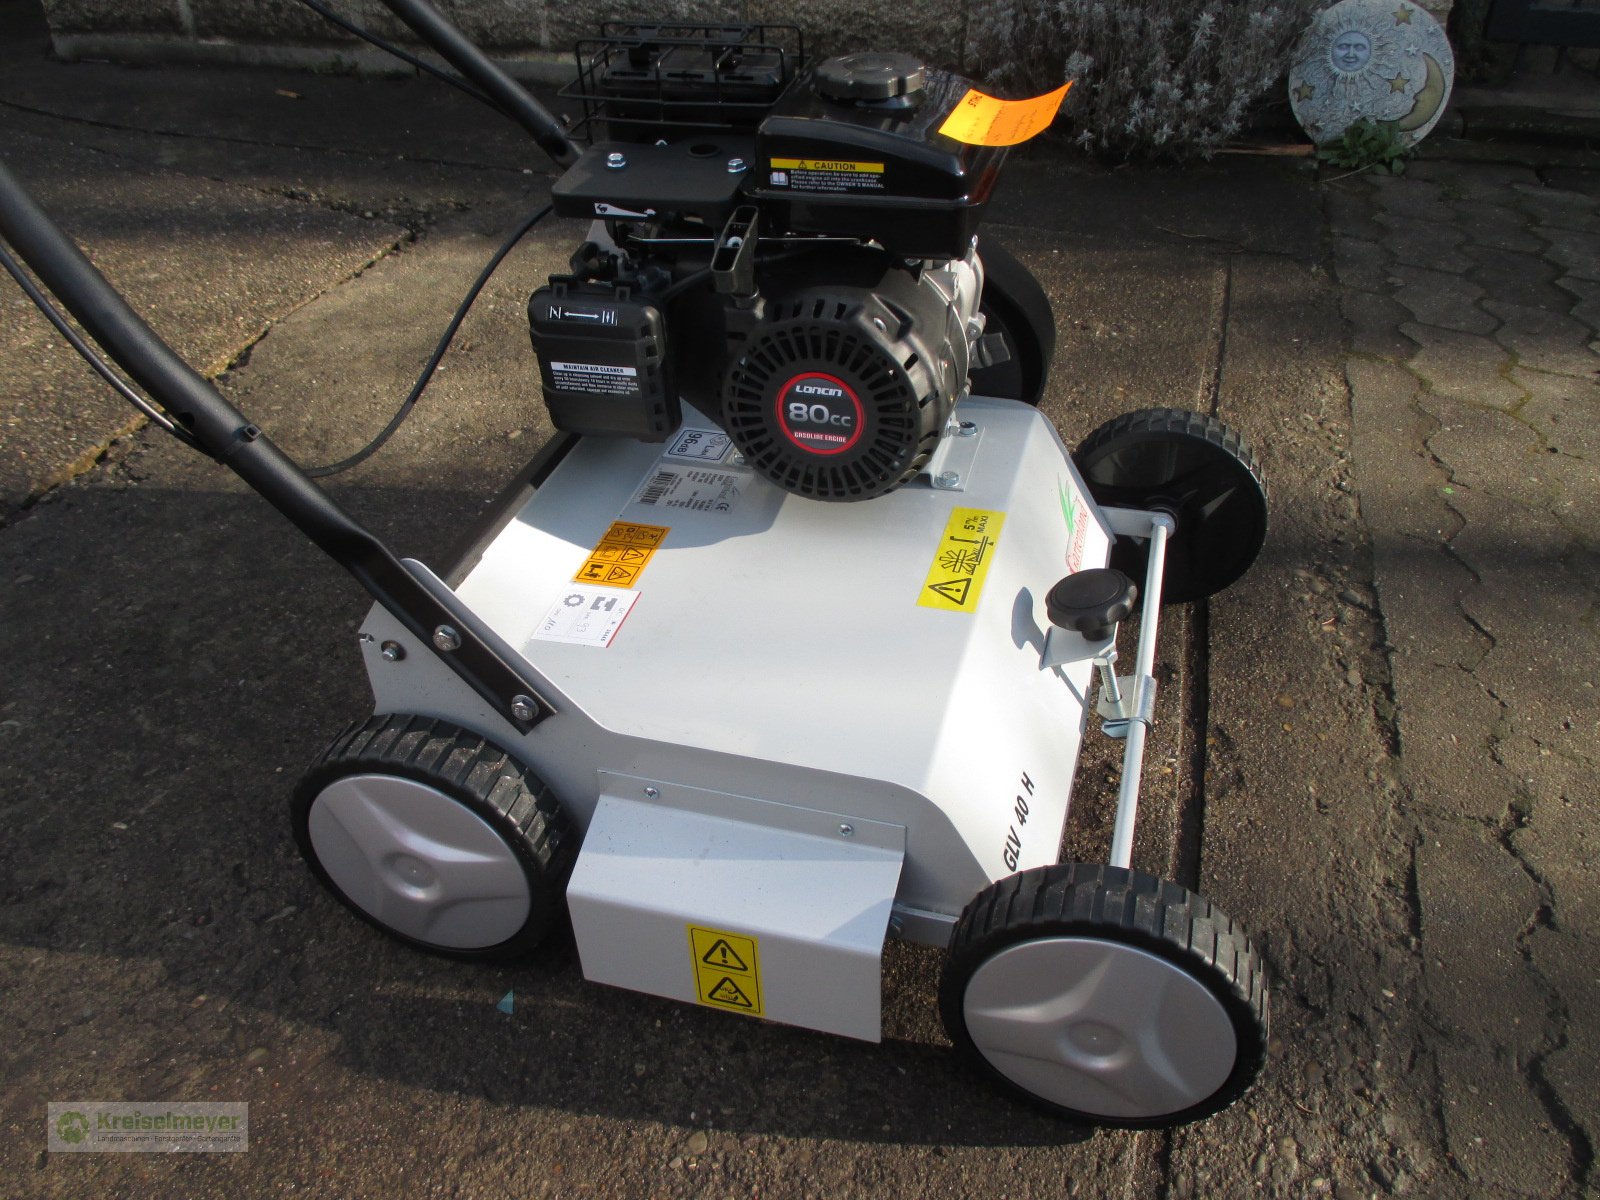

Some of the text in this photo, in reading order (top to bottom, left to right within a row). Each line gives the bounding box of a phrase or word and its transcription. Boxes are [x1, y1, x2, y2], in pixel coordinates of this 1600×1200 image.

[814, 162, 856, 170] CAUTION
[794, 432, 846, 443] GASOLINE ENGINE
[976, 515, 989, 533] MAXI
[1003, 771, 1035, 872] GLV 40 H
